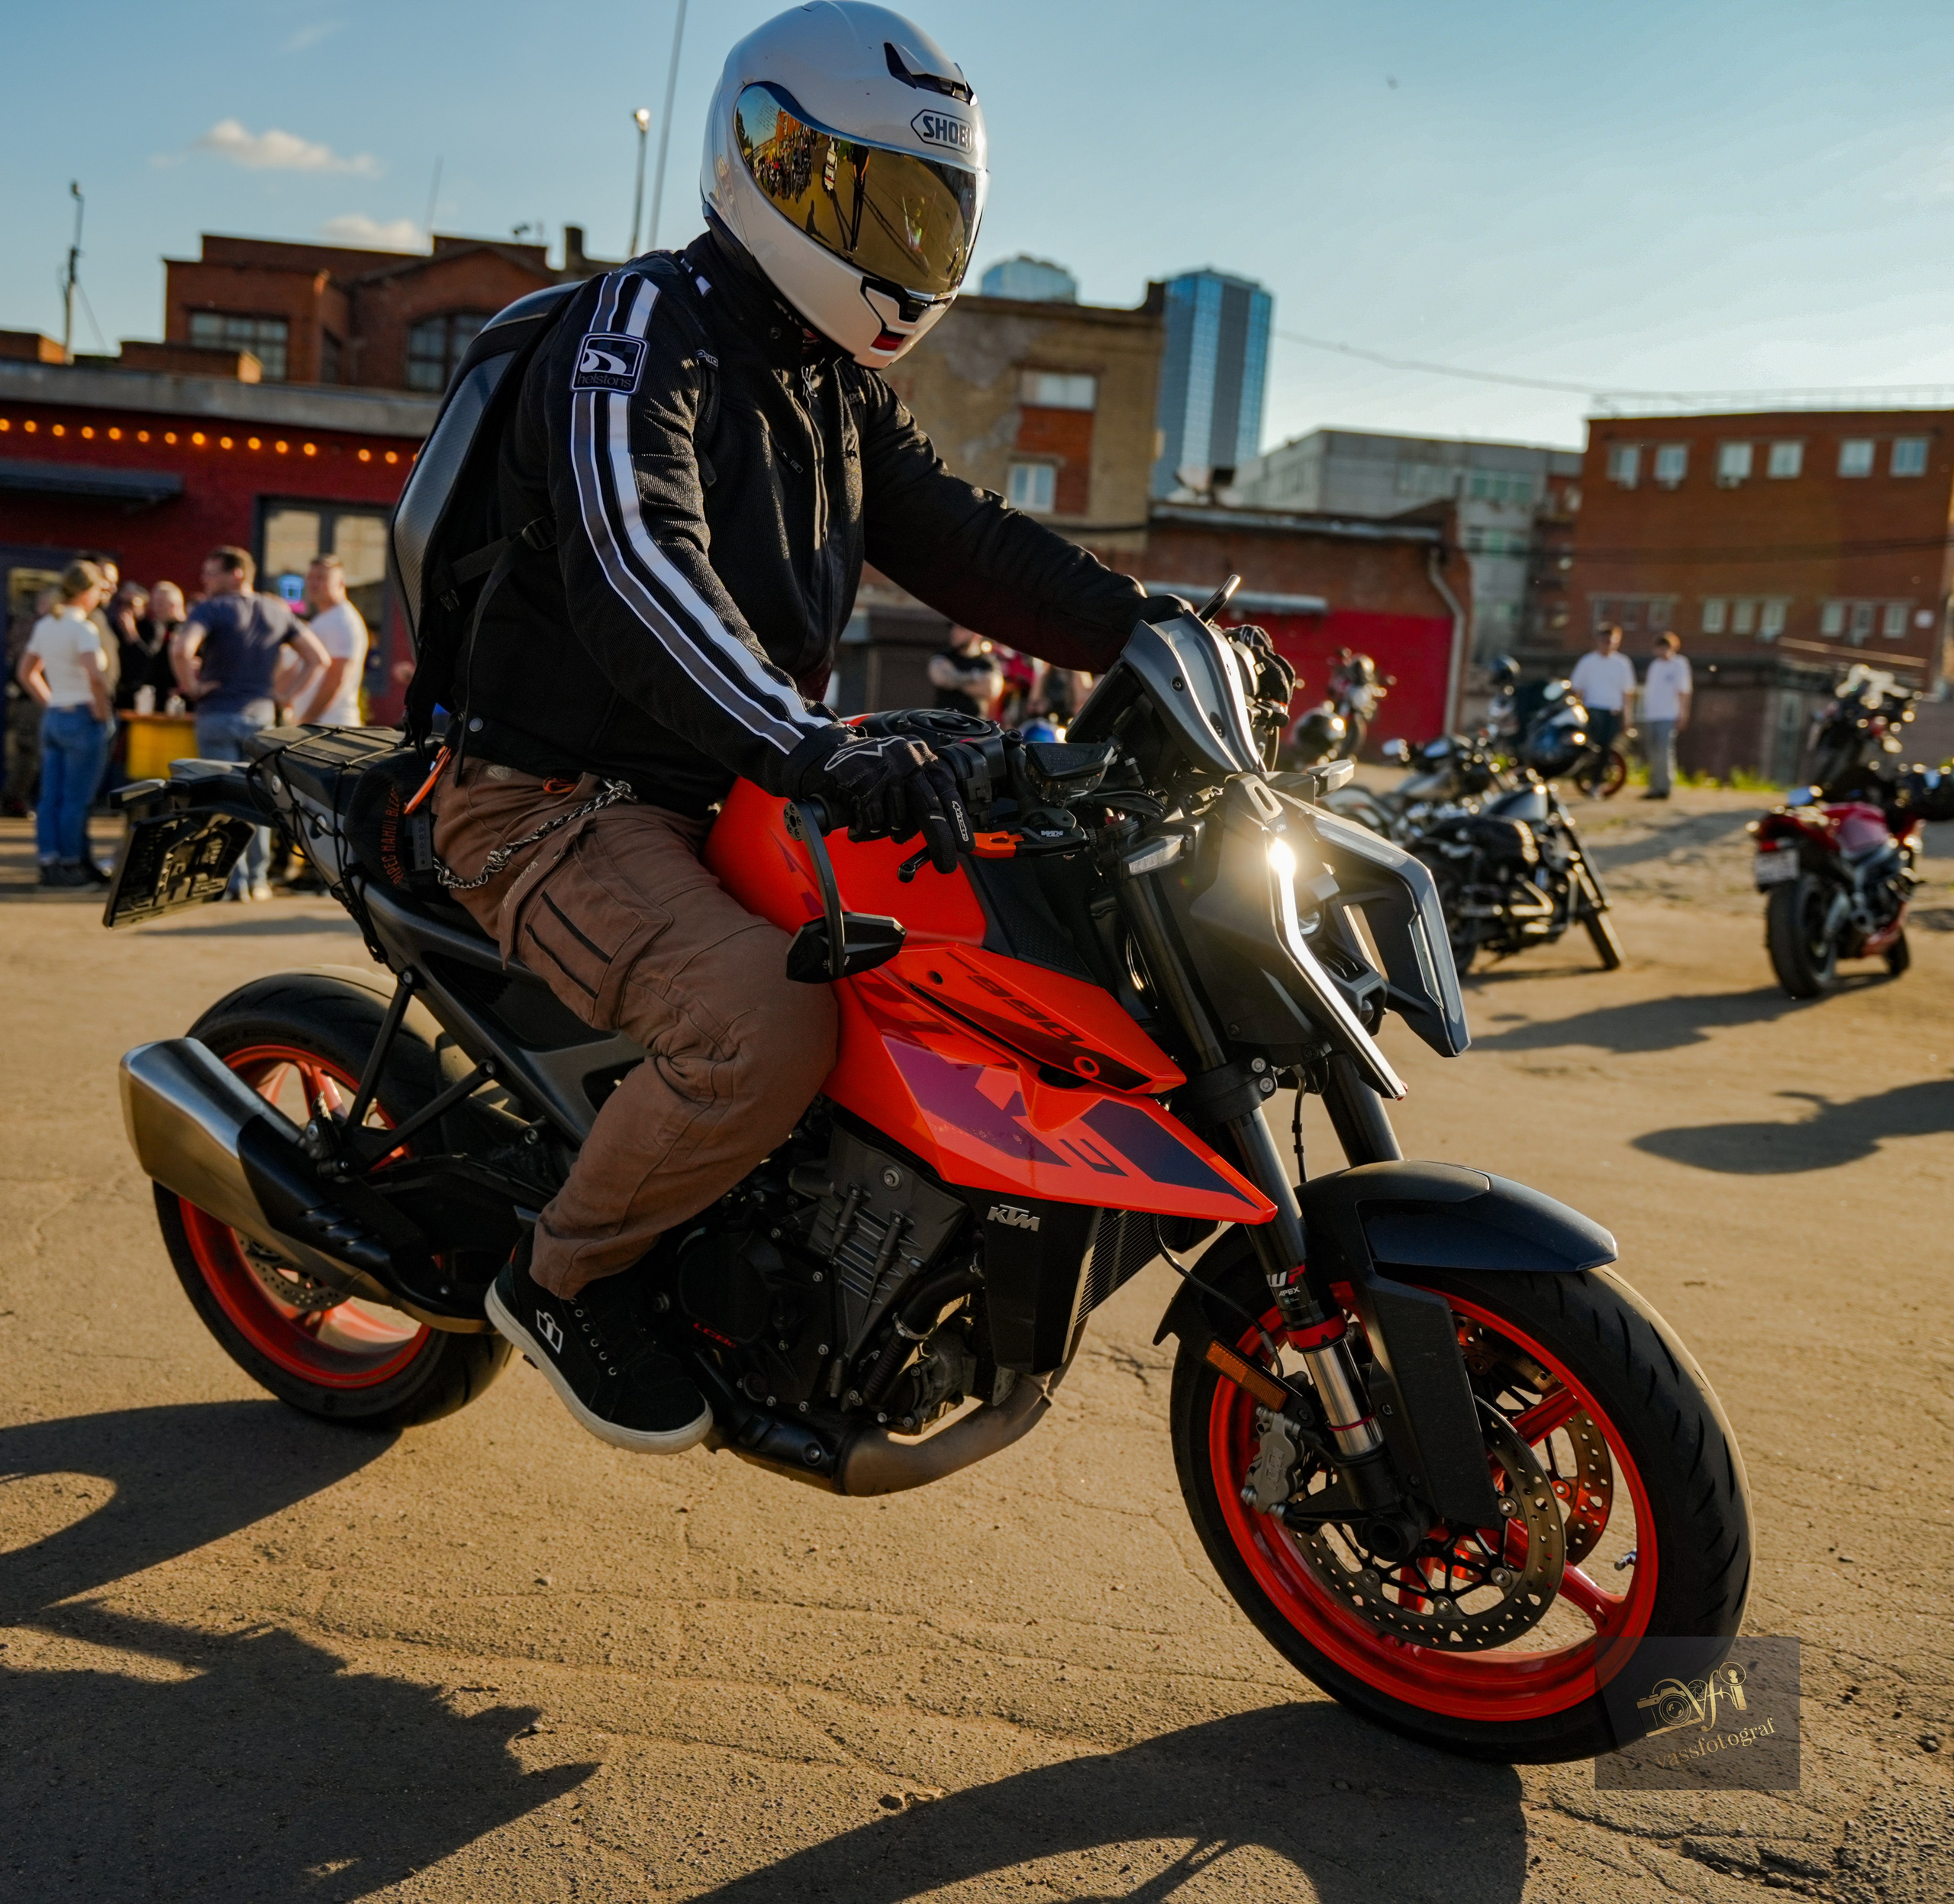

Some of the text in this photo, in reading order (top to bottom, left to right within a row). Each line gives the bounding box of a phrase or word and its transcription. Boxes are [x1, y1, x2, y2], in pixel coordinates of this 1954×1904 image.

[922, 115, 971, 150] SHOEI
[577, 373, 632, 389] helstons
[986, 1203, 1040, 1232] KTM
[1266, 1263, 1306, 1288] WP
[1278, 1286, 1301, 1297] APEX
